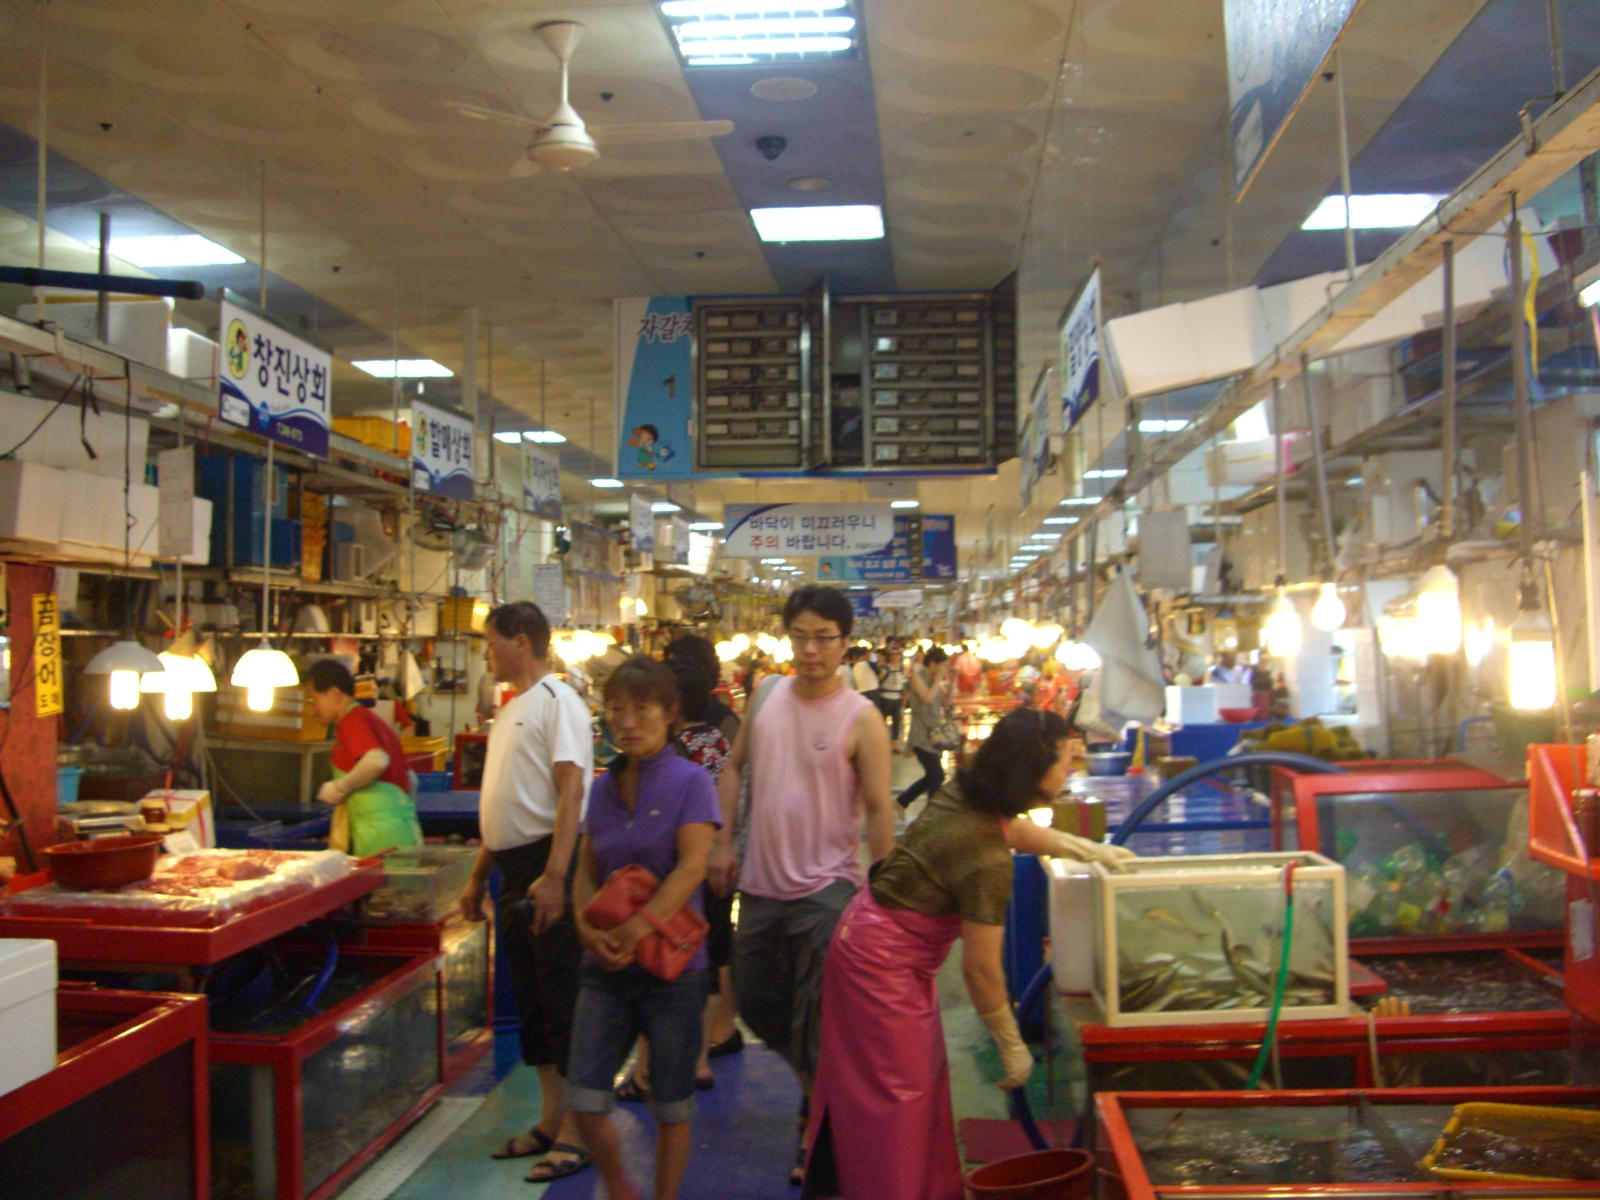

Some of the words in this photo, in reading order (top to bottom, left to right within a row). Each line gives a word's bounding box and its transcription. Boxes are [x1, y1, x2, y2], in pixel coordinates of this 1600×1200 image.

[253, 333, 327, 413] 창진상회
[750, 515, 795, 531] 바닥이
[801, 514, 877, 532] 미끄러우니
[750, 535, 780, 550] 주의
[786, 534, 851, 551] 바랍니다.
